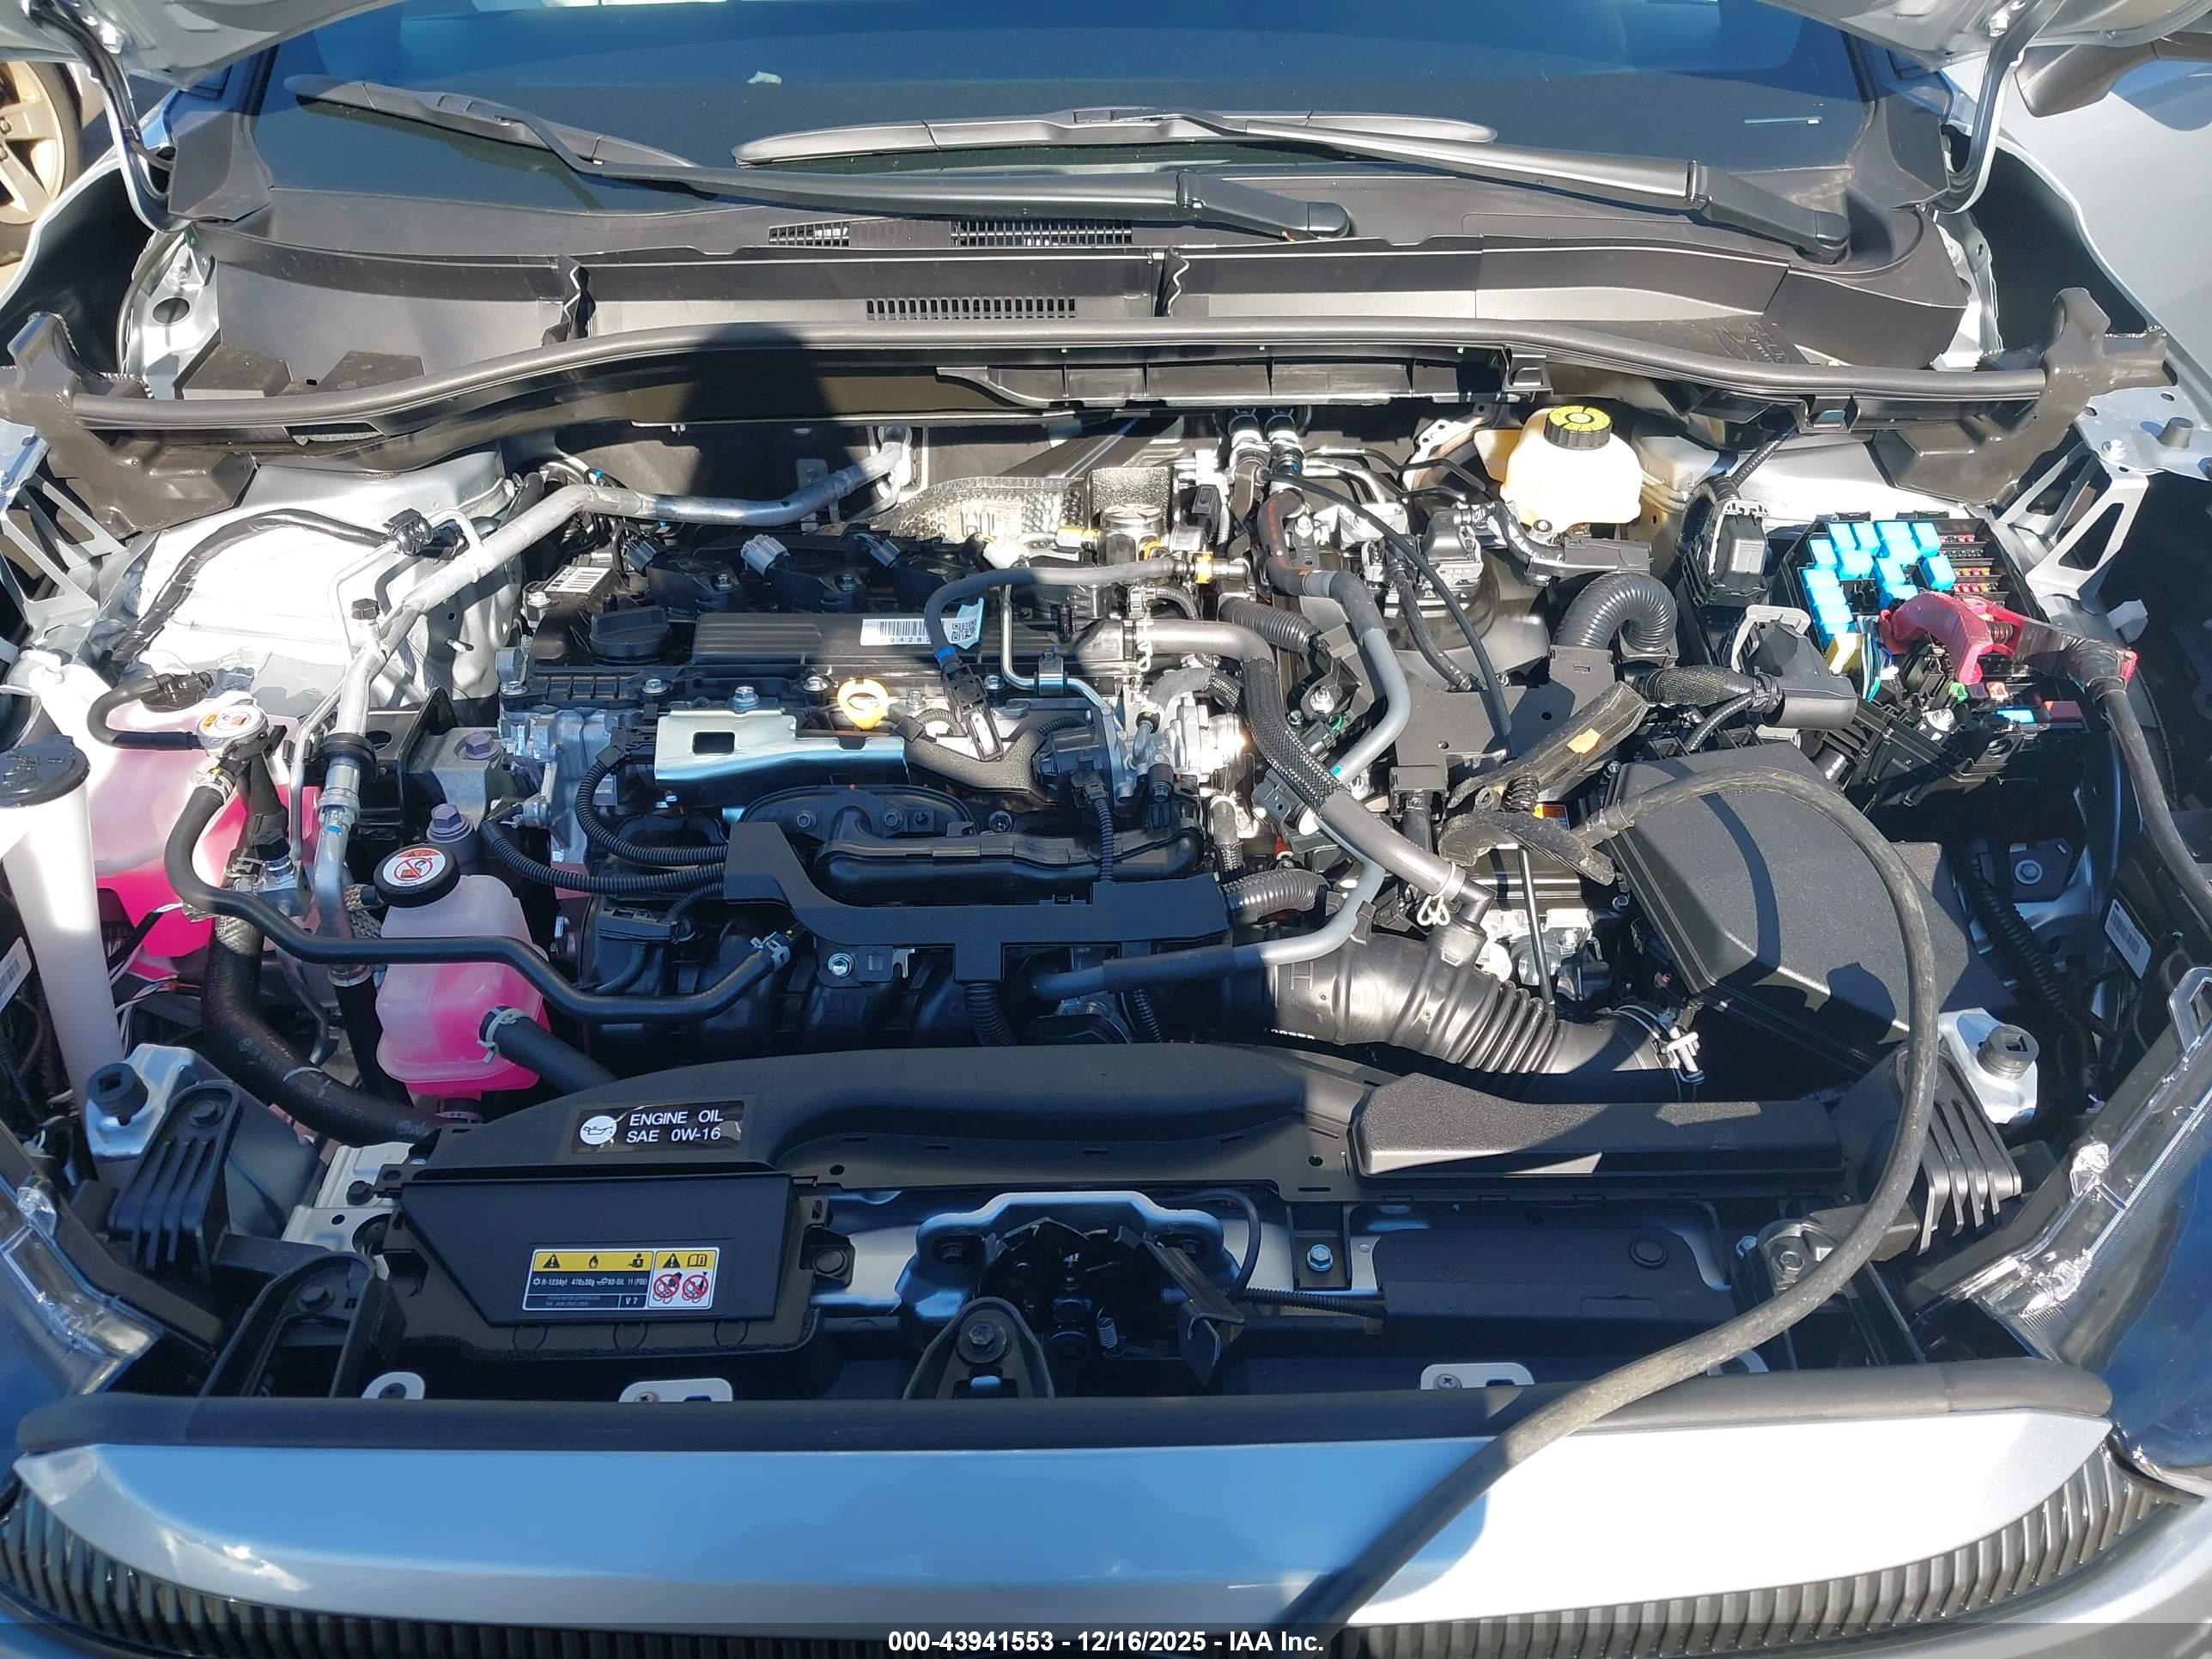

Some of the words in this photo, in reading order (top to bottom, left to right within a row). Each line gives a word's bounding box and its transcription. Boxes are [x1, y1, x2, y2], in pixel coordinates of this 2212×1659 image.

[629, 1111, 688, 1126] ENGINE
[698, 1109, 724, 1123] OIL
[626, 1129, 660, 1144] SAE
[671, 1127, 721, 1142] 0W-16
